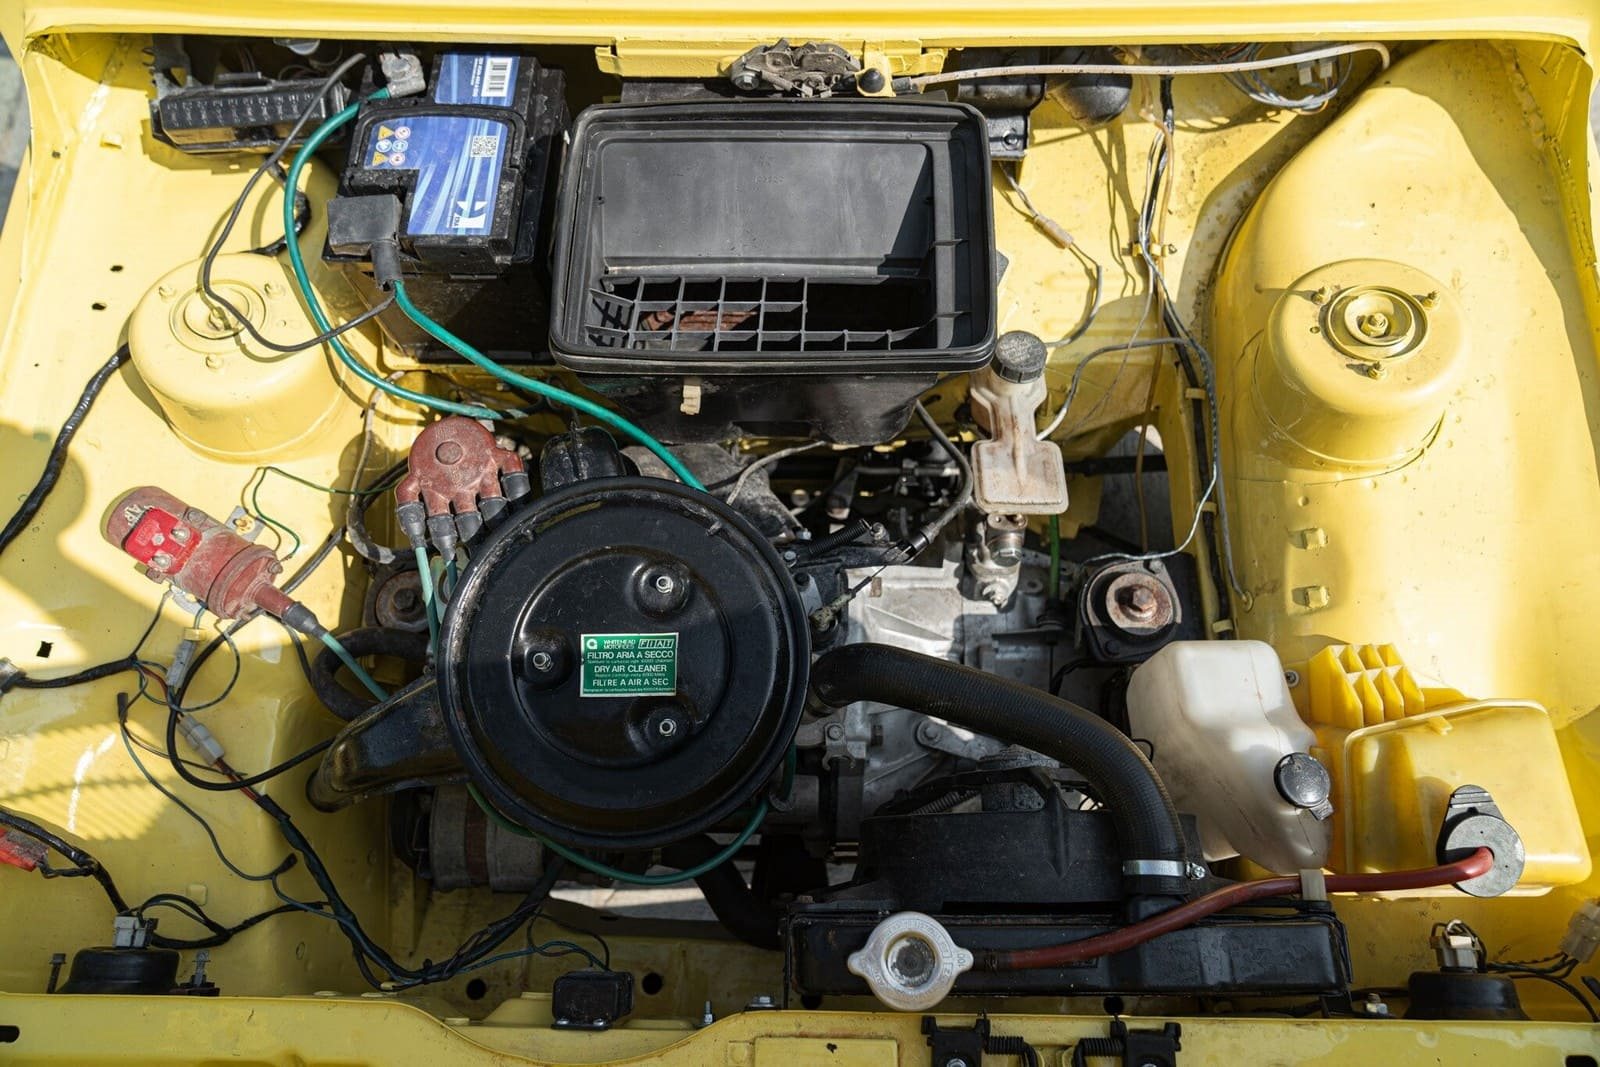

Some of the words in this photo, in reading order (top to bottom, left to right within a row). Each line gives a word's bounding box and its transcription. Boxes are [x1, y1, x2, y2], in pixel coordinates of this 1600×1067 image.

[639, 639, 673, 648] FIAT
[587, 651, 614, 659] FILTRO
[616, 651, 635, 659] ARIA
[636, 651, 643, 659] A
[644, 650, 674, 659] SECCO
[594, 665, 611, 673] DRY
[627, 664, 667, 672] CLEANER
[627, 678, 642, 686] AIR
[643, 678, 650, 686] A
[651, 678, 669, 686] SEC
